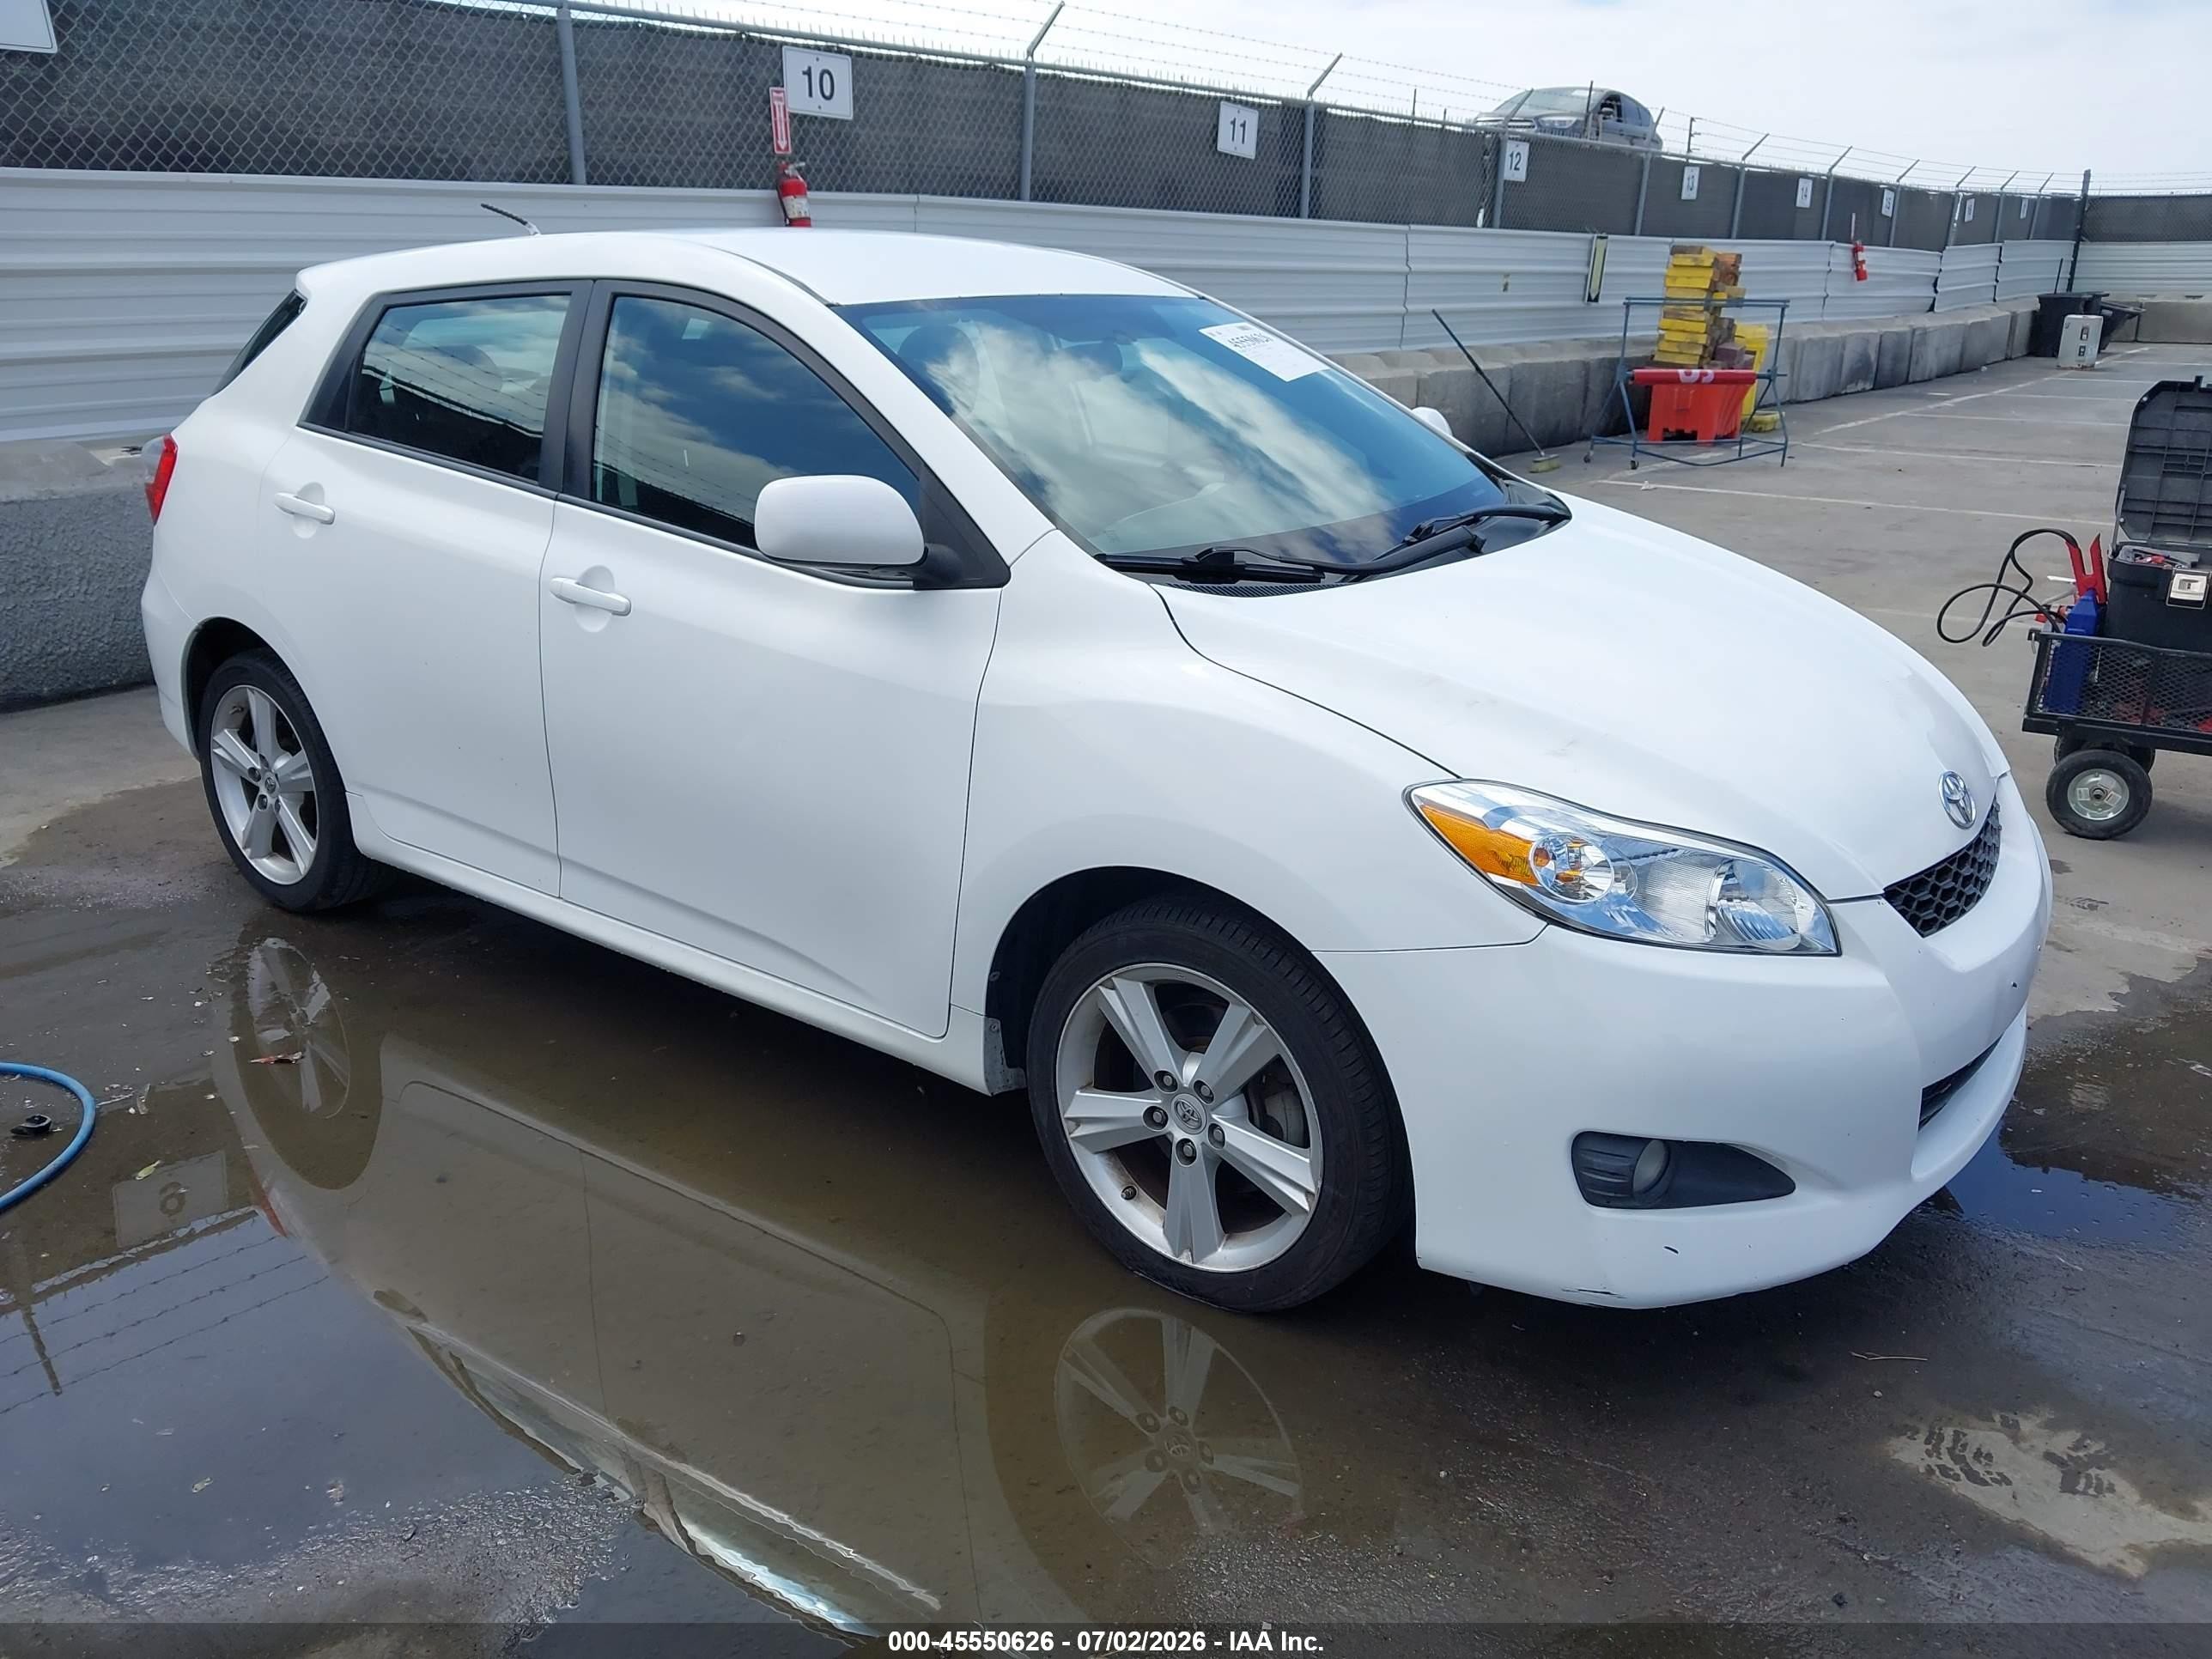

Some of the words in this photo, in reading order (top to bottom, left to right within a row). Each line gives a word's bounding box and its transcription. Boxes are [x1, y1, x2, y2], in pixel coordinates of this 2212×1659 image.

[802, 66, 835, 100] 10
[1230, 117, 1247, 145] 11
[1509, 151, 1522, 171] 12
